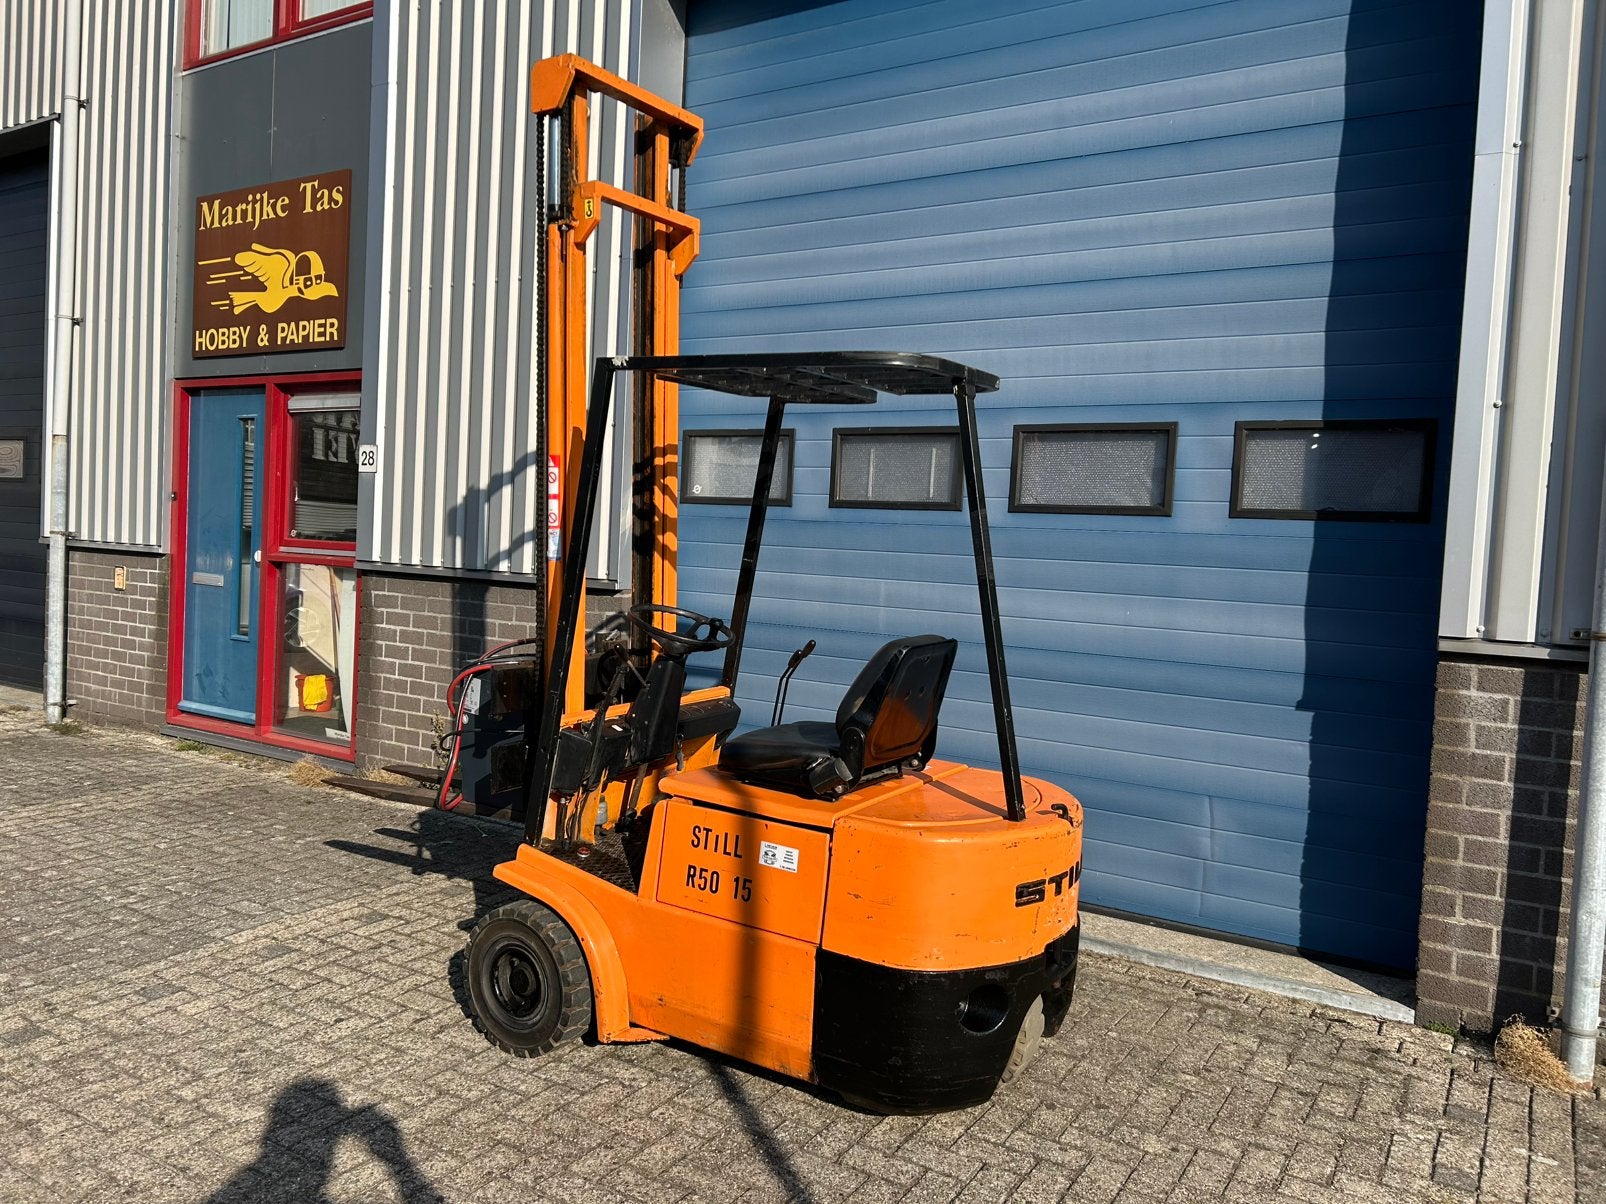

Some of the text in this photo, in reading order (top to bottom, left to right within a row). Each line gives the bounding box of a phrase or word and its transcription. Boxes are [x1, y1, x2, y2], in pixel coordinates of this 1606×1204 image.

[199, 179, 344, 231] Marijke Tas
[195, 318, 339, 351] HOBBY & PAPIER
[361, 450, 375, 466] 28
[686, 864, 753, 902] R50 15
